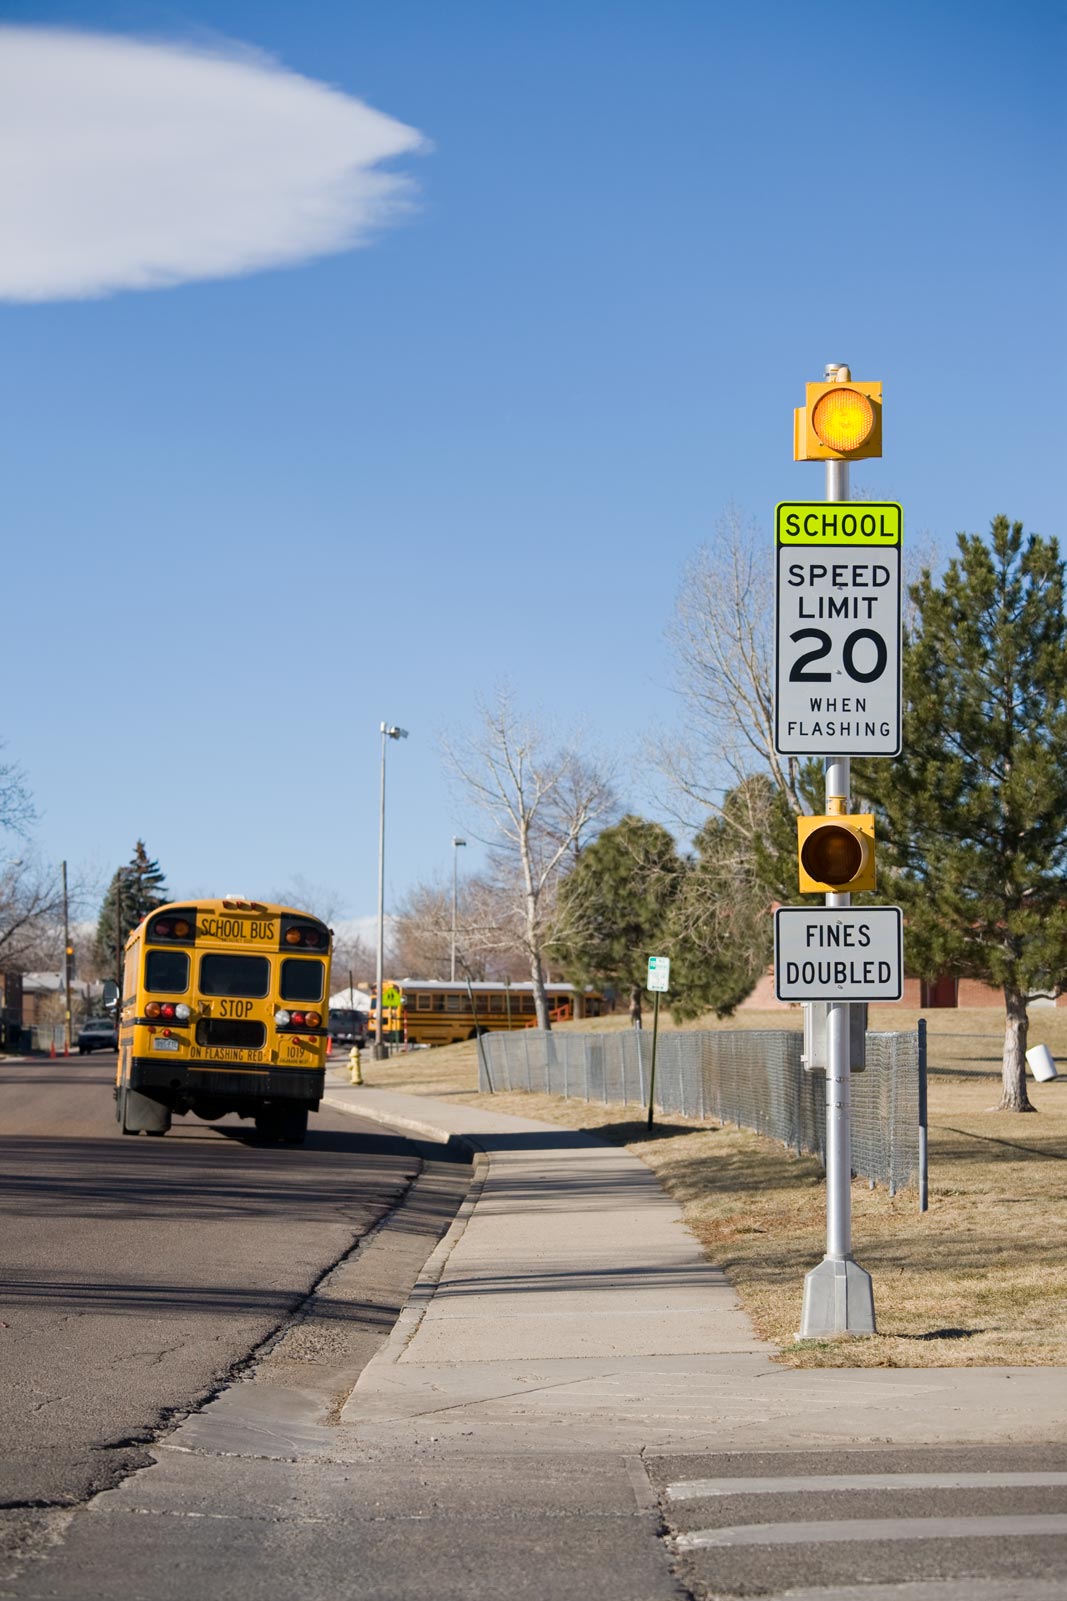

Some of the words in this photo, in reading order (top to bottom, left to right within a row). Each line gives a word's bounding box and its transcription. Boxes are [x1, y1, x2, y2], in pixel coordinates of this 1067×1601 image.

[785, 513, 894, 537] SCHOOL
[787, 564, 891, 587] SPEED
[798, 596, 879, 619] LIMIT
[788, 627, 888, 684] 20
[809, 698, 867, 712] WHEN
[787, 721, 890, 737] FLASHING
[201, 918, 247, 938] SCHOOL
[250, 921, 274, 940] BUS
[806, 924, 871, 947] FINES
[786, 961, 891, 984] DOUBLED
[219, 1000, 253, 1018] STOP
[190, 1047, 201, 1058] ON
[205, 1048, 244, 1061] FLASHING
[247, 1050, 263, 1062] RED
[287, 1046, 305, 1058] 1019
